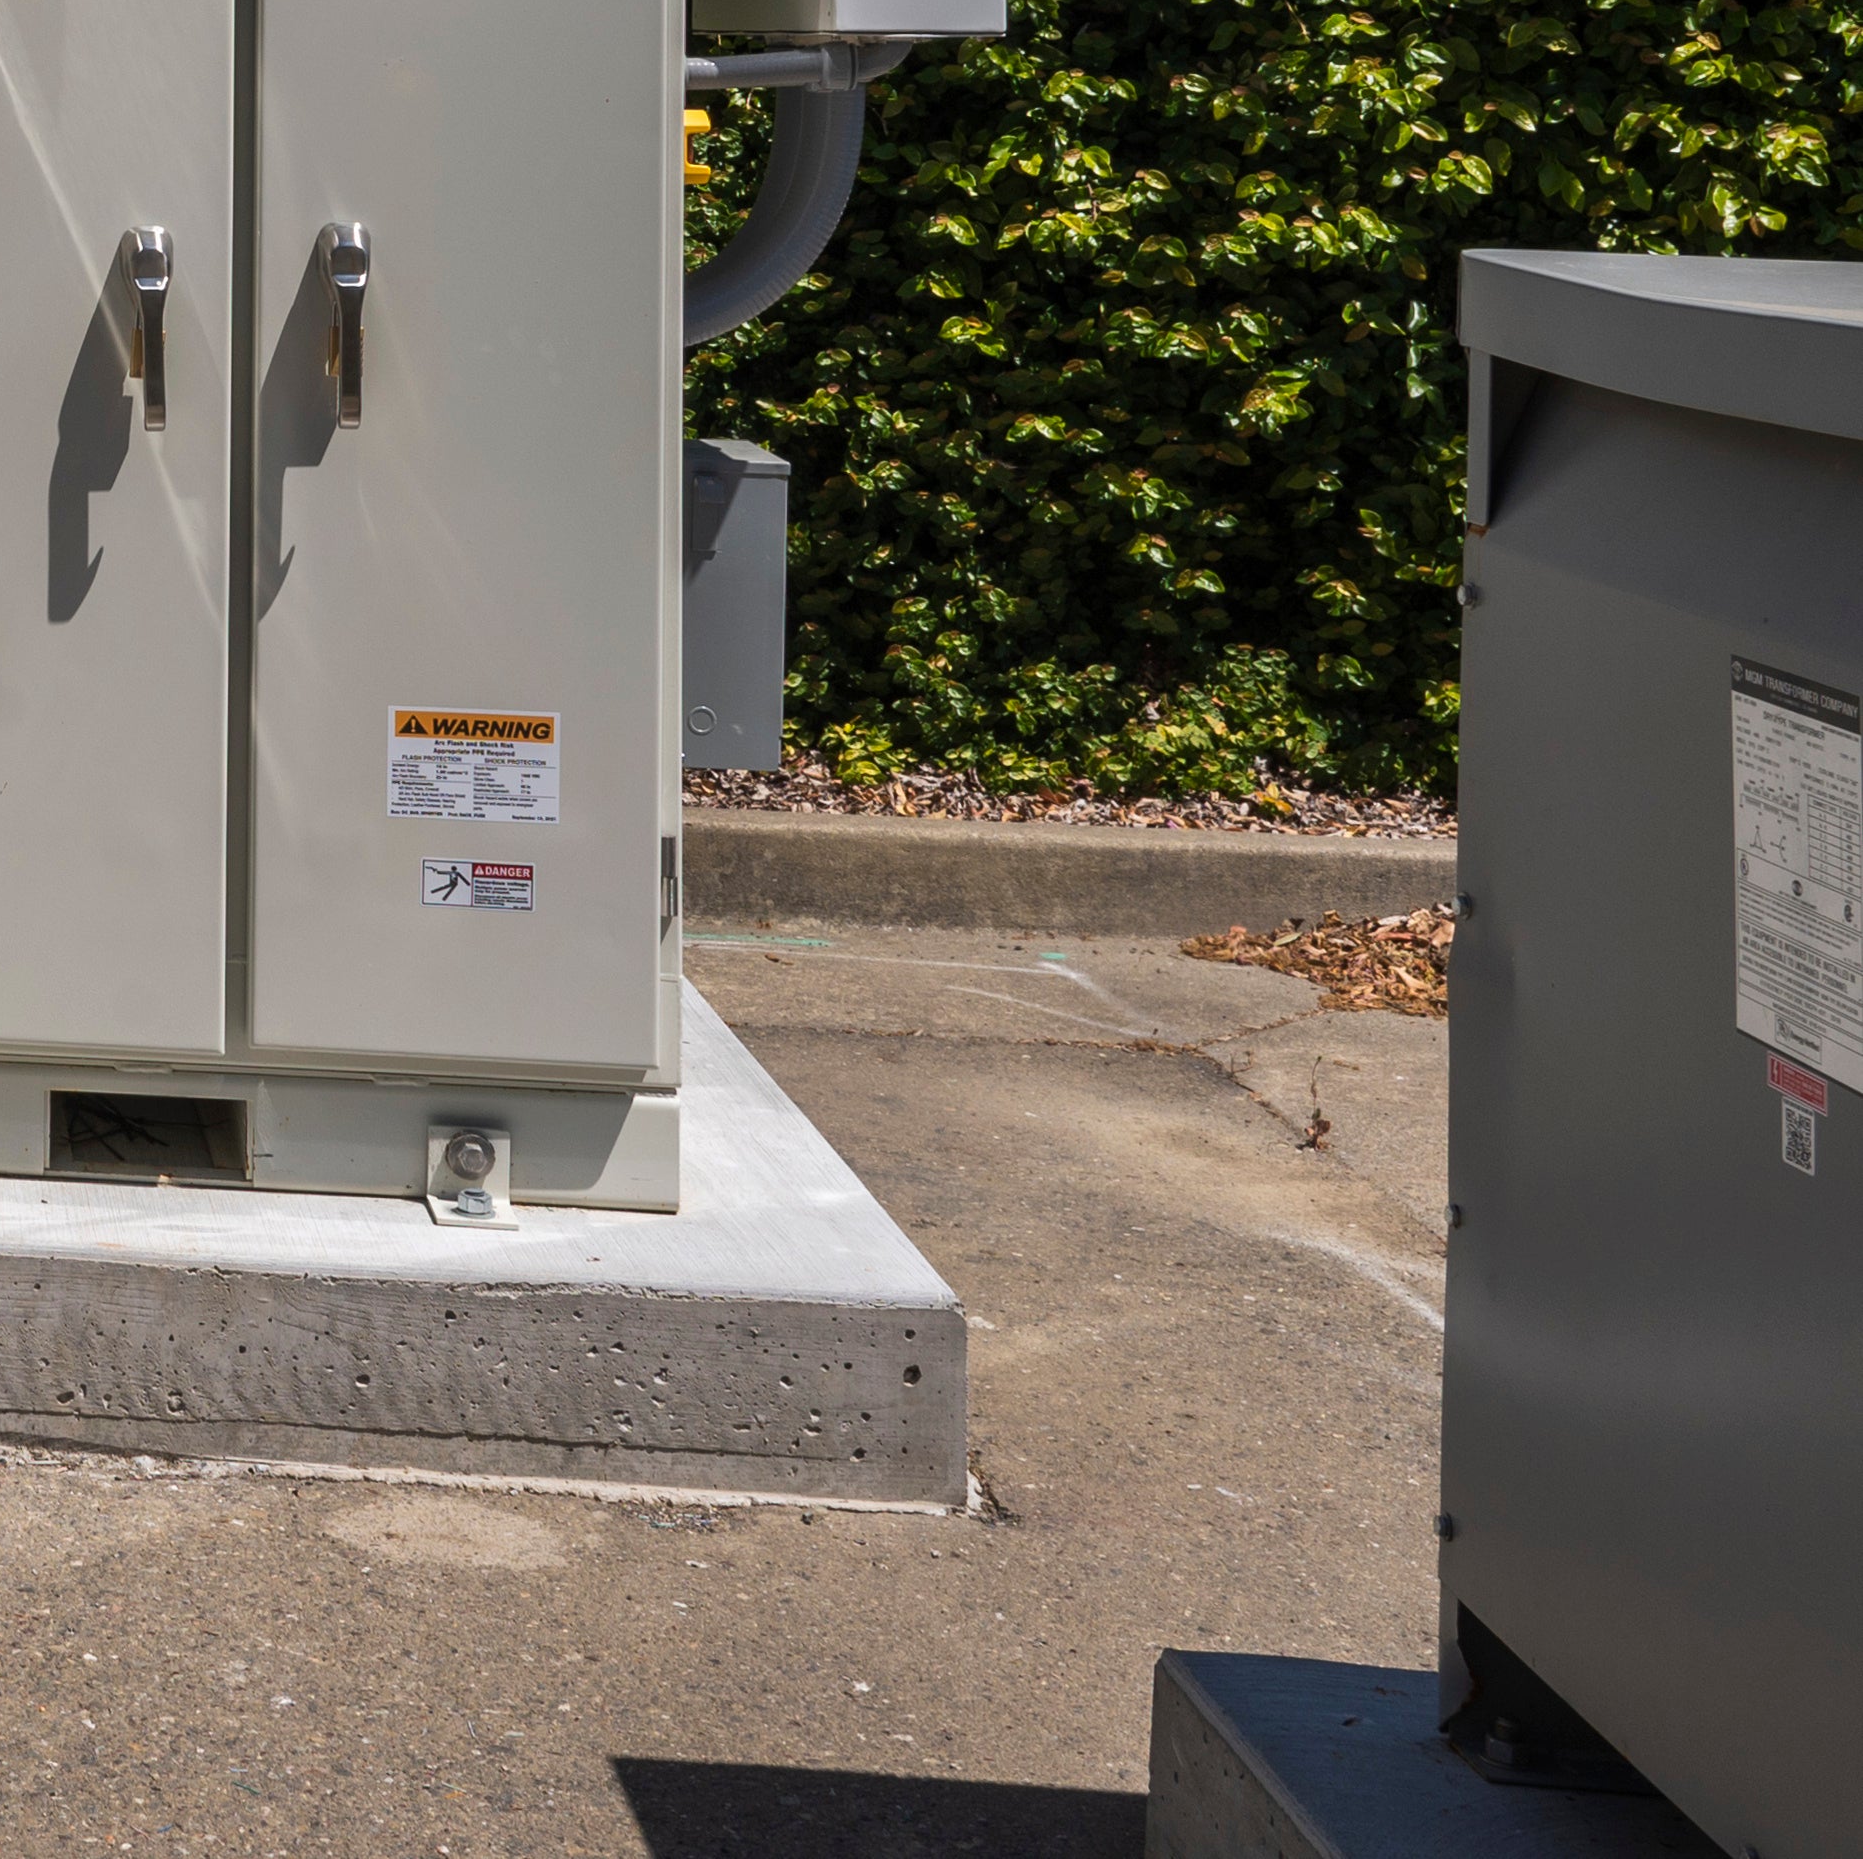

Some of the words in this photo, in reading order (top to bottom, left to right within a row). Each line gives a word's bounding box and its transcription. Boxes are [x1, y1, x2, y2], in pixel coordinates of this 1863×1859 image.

[1744, 668, 1764, 686] MGM
[1764, 675, 1820, 707] TRANSFORMER
[1820, 694, 1860, 719] COMPANY
[432, 717, 552, 740] WARNING
[423, 755, 462, 763] PROTECTION
[484, 757, 506, 765] SHOCK
[506, 758, 546, 767] PROTECTION
[485, 865, 531, 878] DANGER
